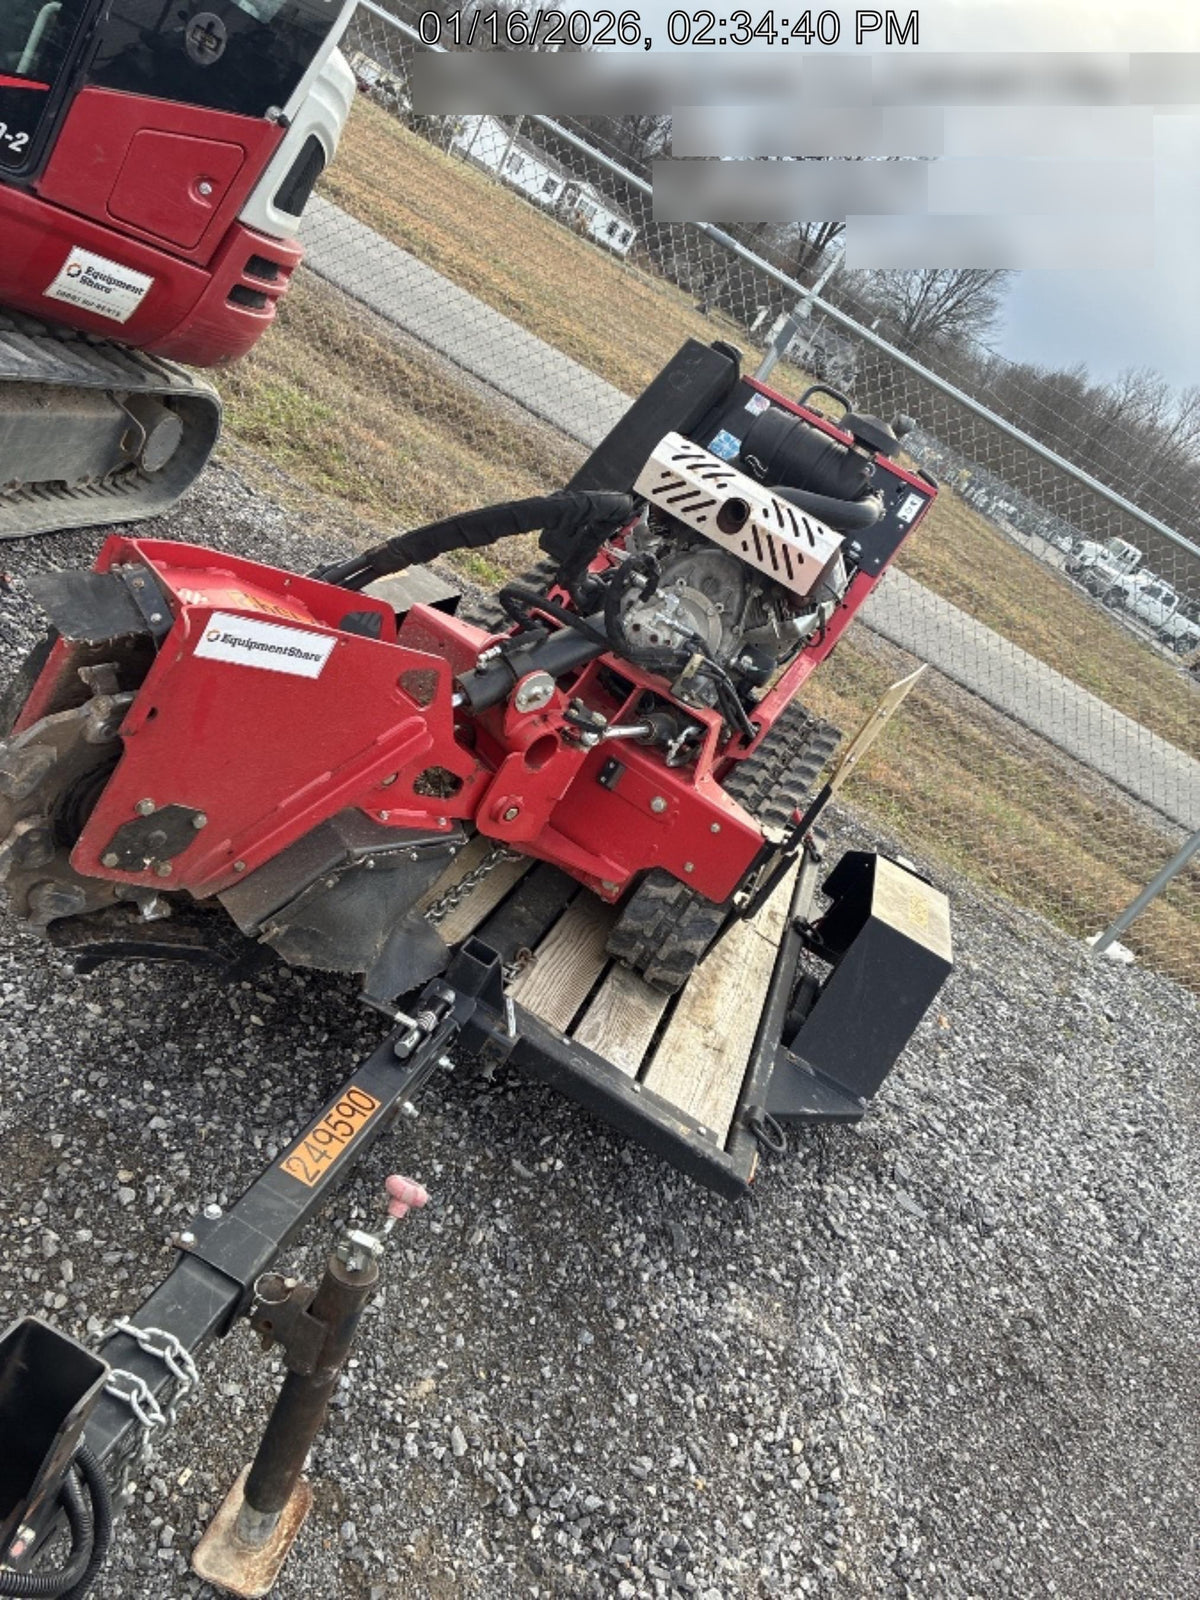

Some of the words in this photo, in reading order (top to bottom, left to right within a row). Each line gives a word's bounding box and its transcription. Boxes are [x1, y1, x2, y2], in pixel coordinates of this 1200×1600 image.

[80, 275, 112, 294] Share
[84, 266, 145, 295] Equipment
[220, 632, 322, 662] EquipmentShare
[286, 1089, 376, 1183] 249590
